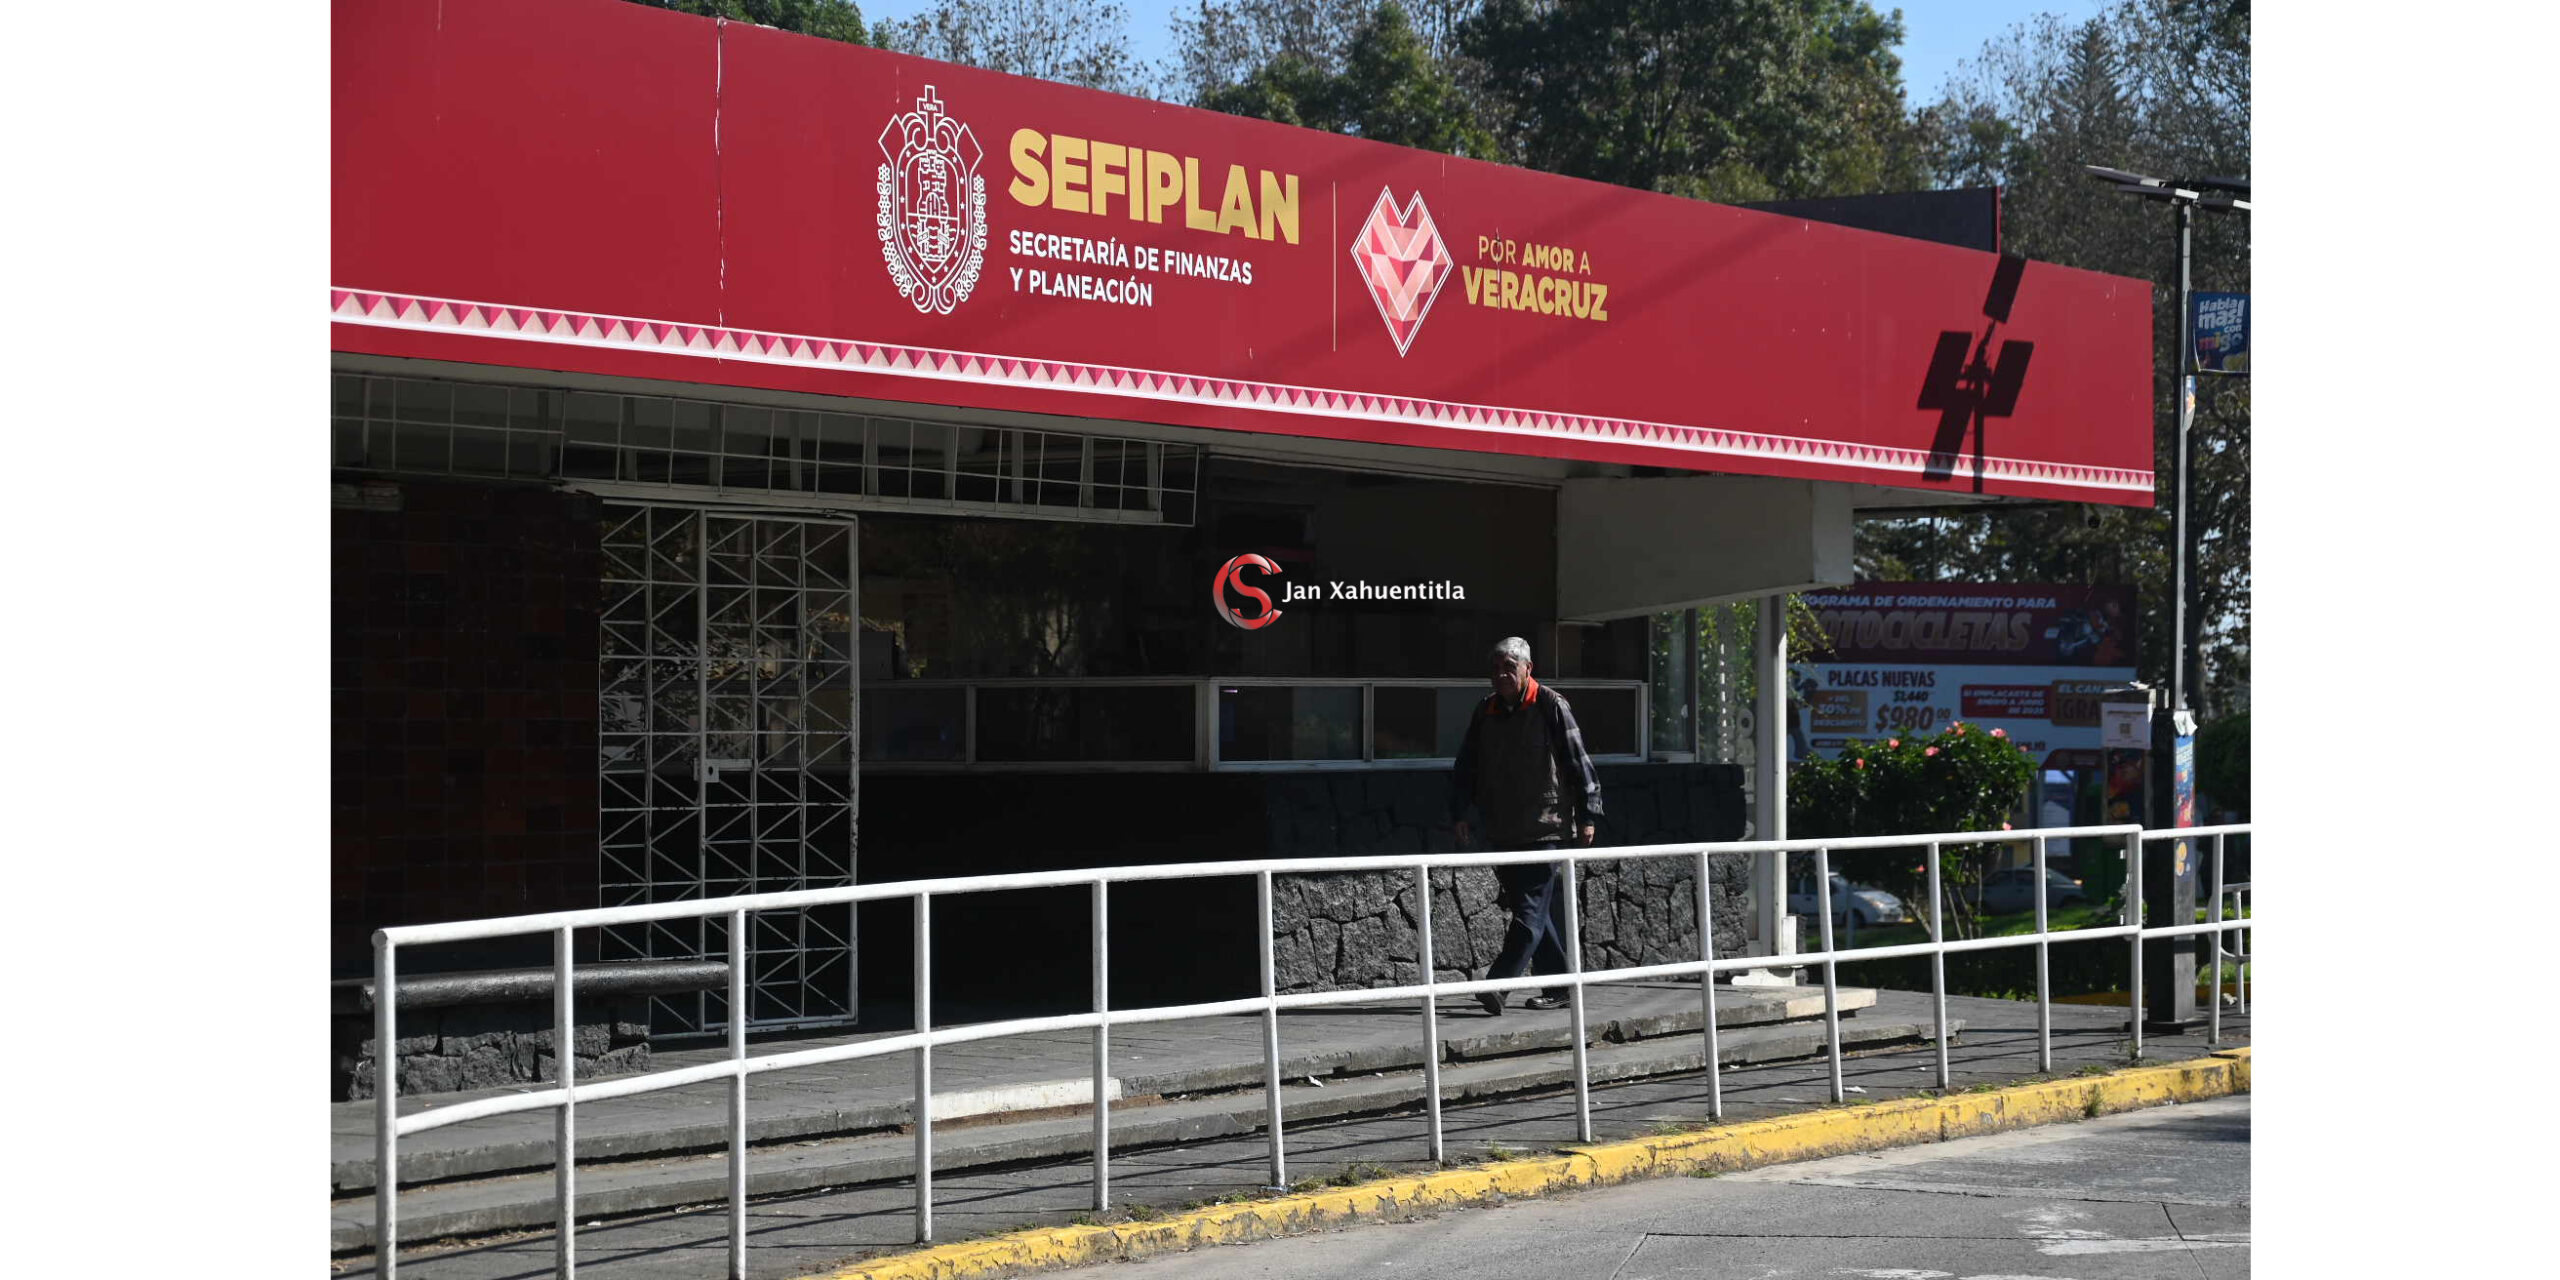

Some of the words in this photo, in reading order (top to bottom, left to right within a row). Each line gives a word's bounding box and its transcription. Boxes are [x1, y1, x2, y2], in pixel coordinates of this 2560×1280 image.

[1008, 128, 1299, 245] SEFIPLAN
[1009, 229, 1129, 268] SECRETARÍA
[1134, 246, 1159, 272] DE
[1164, 249, 1253, 285] FINANZAS
[1478, 235, 1516, 265] POR
[1522, 242, 1574, 273] AMOR
[1579, 251, 1591, 275] A
[1009, 266, 1023, 292] Y
[1029, 269, 1152, 307] PLANEACIÓN
[1462, 265, 1608, 322] VERACRUZ
[1875, 596, 1893, 608] DE
[1897, 596, 2014, 609] ORDENAMIENTO
[2016, 598, 2056, 609] PARA
[1815, 610, 2032, 650] OTOCICLETAS
[1828, 670, 1878, 687] PLACAS
[1882, 671, 1935, 688] NUEVAS
